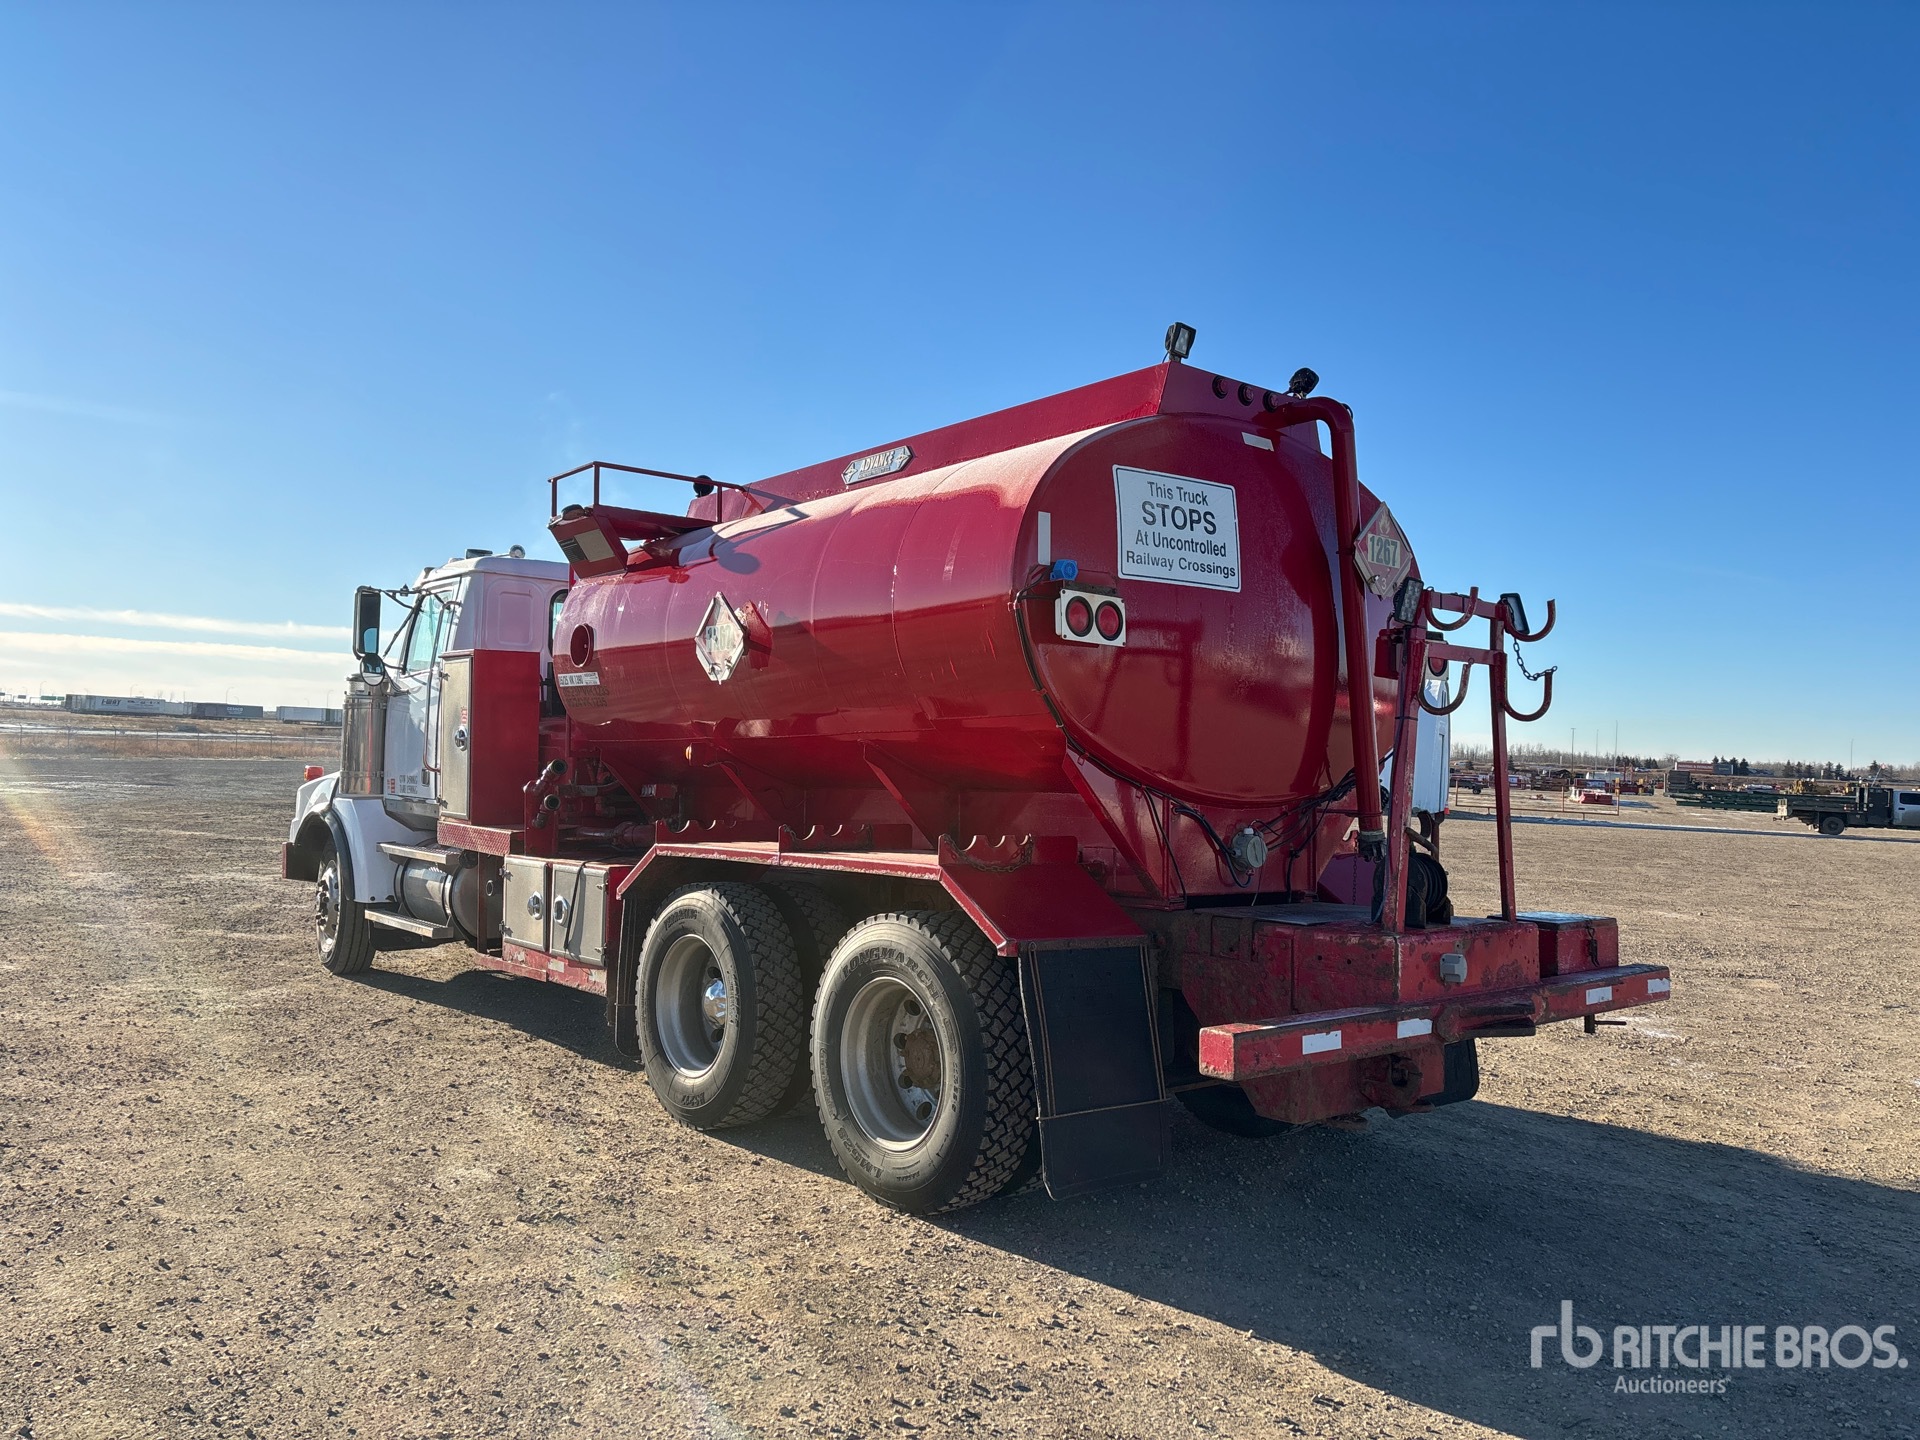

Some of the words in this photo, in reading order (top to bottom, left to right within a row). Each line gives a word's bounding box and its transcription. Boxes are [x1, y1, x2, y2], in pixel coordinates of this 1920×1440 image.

[1147, 481, 1174, 501] This
[1177, 486, 1209, 506] Truck
[1141, 500, 1217, 535] STOPS
[1135, 529, 1149, 546] At
[1153, 532, 1226, 558] Uncontrolled
[1369, 535, 1398, 567] 1267
[1126, 551, 1174, 571] Railway
[1179, 557, 1236, 579] Crossings
[843, 947, 941, 999] LONGMARCH
